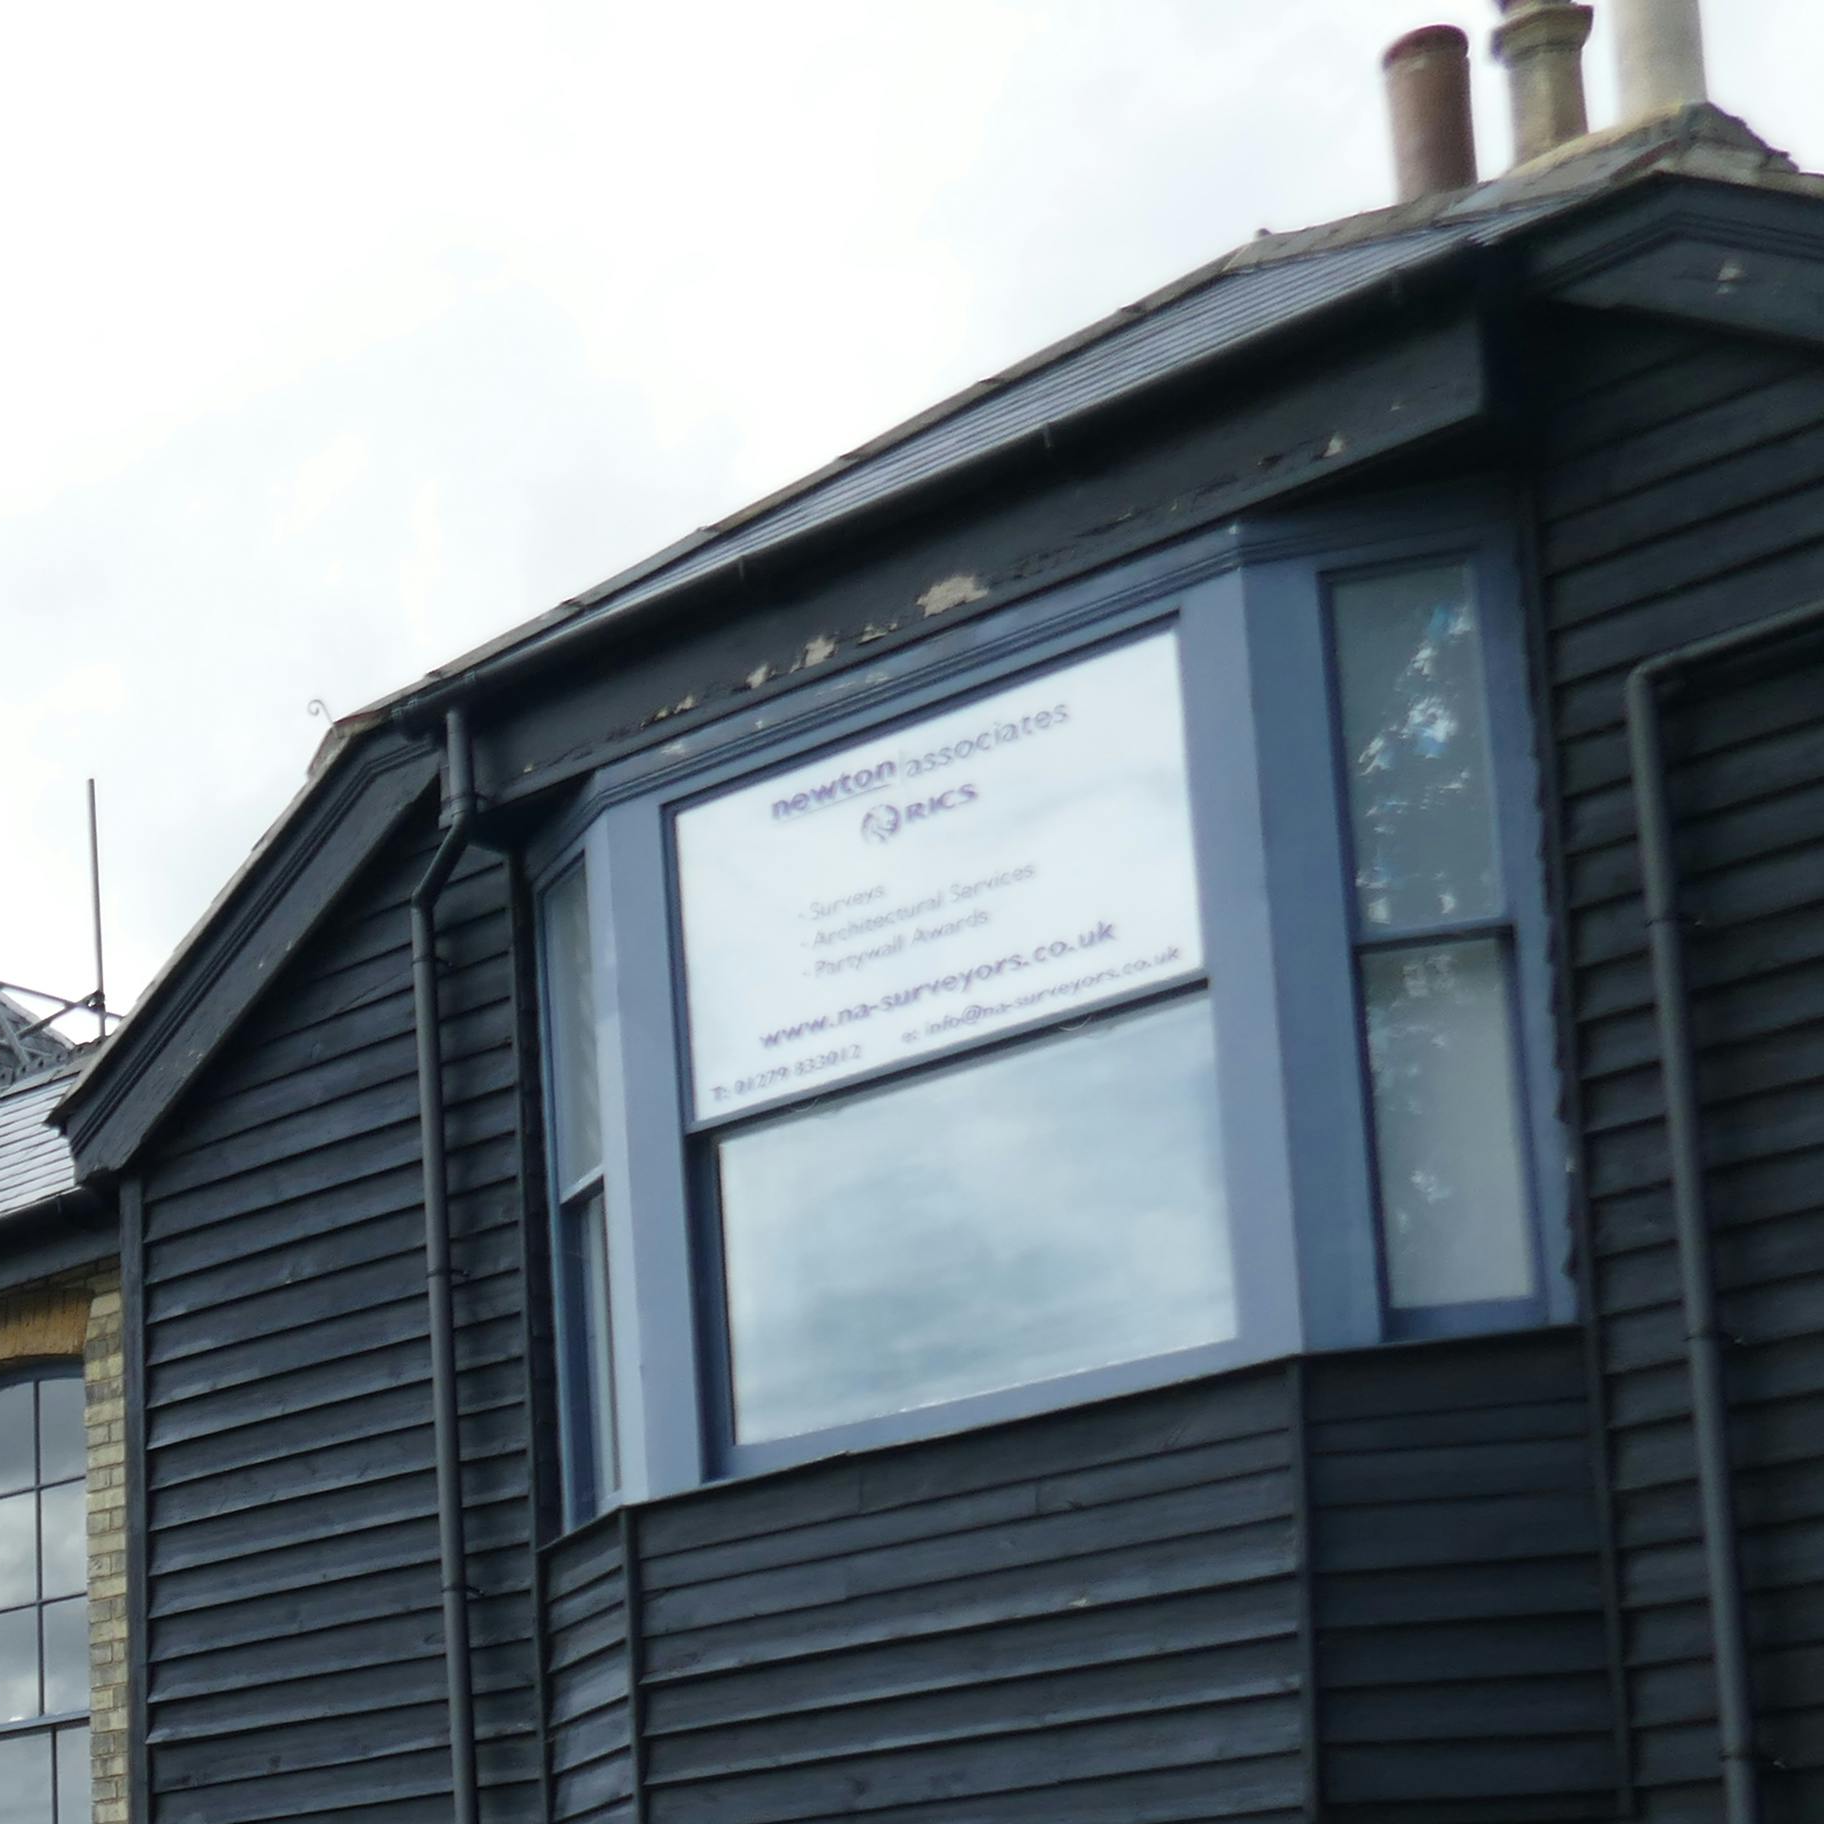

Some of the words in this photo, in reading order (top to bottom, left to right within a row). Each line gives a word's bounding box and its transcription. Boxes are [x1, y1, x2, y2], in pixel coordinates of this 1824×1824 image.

[771, 760, 898, 820] newton
[905, 703, 1071, 779] associates
[905, 782, 980, 823] RICS
[809, 885, 888, 921] Surveys
[813, 891, 944, 948] Architectural
[950, 862, 1038, 903] Services
[911, 909, 990, 945] Awards
[759, 920, 1118, 1050] www.na-surveyors.co.uk
[923, 944, 1181, 1039] info@na-surveyors.co.uk
